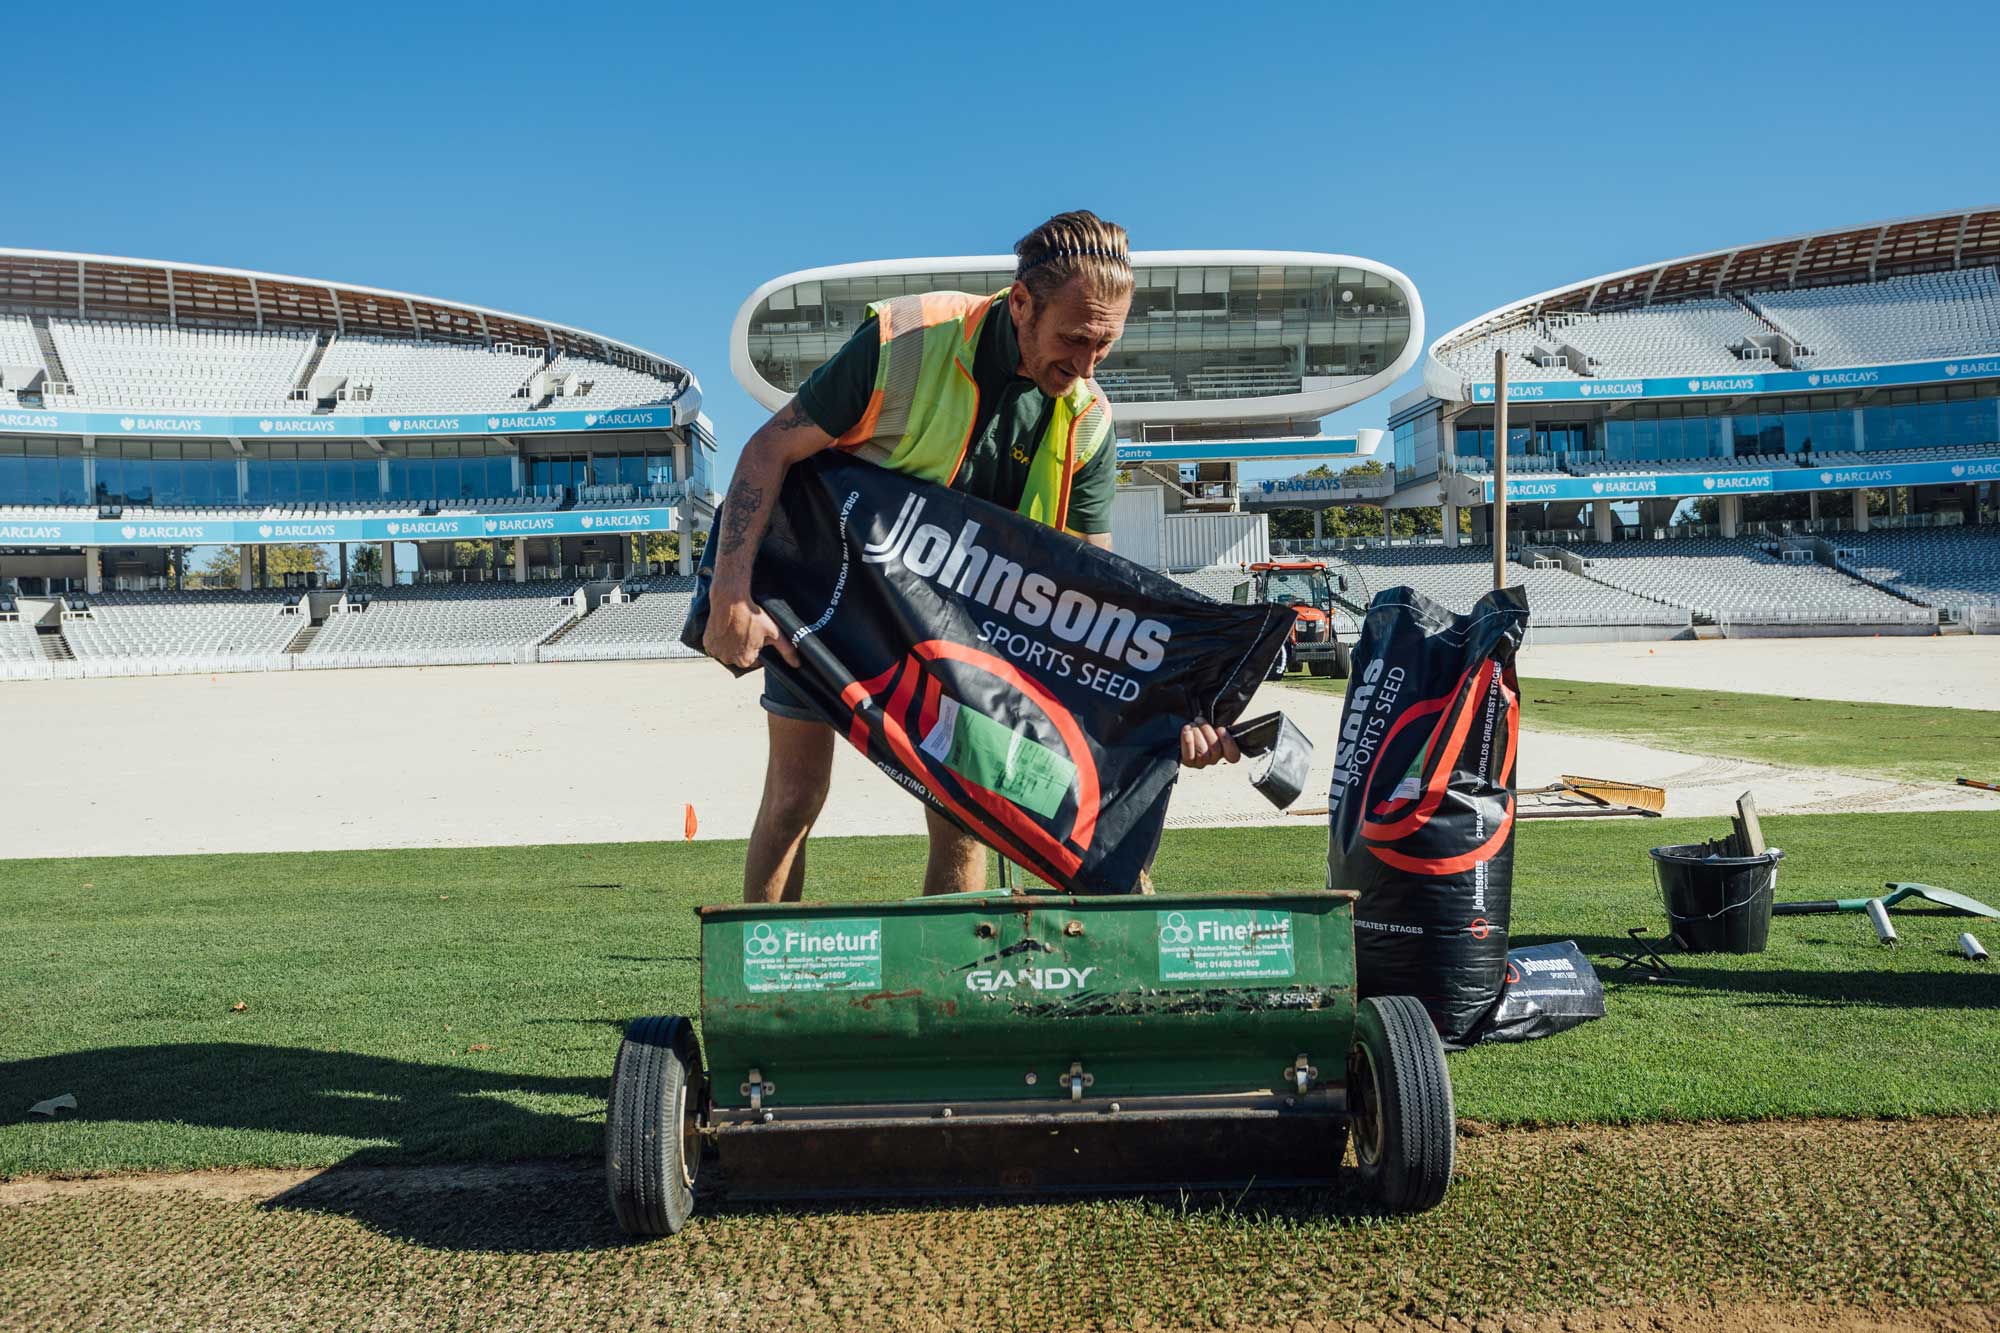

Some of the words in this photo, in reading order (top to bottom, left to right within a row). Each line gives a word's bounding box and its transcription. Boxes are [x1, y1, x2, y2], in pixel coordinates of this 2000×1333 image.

[1961, 362, 2000, 374] BARCL
[1822, 372, 1879, 384] BARCLAYS
[1493, 386, 1543, 397] RCLAYS
[1593, 383, 1643, 395] BARCLAYS
[1702, 379, 1754, 391] BARCLAYS
[0, 414, 58, 427] ARCLAYS
[137, 418, 201, 431] BARCLAYS
[403, 418, 459, 431] BARCLAYS
[502, 416, 556, 428] BARCLAYS
[599, 413, 653, 425] BARCLAYS
[275, 420, 335, 432] BARCLAYS
[1117, 449, 1152, 458] Centre
[1835, 470, 1892, 483] BARCLAYS
[1968, 464, 2000, 476] BARC
[1279, 479, 1340, 492] BARCLAYS
[1605, 481, 1657, 492] BARCLAYS
[1717, 476, 1770, 488] BARCLAYS
[402, 521, 458, 534] BARCLAYS
[500, 518, 554, 531] BARCLAYS
[595, 514, 650, 528] BARCLAYS
[0, 526, 61, 538] ARCLAYS
[139, 526, 203, 538] BARCLAYS
[275, 525, 335, 537] BARCLAYS
[831, 562, 849, 606] WORLDS
[862, 491, 1171, 672] Johnsons
[977, 620, 1074, 677] SPORTS
[1077, 662, 1140, 702] SEED
[1483, 696, 1496, 743] GREATEST
[1490, 661, 1501, 696] STAGES
[1347, 716, 1385, 787] SPORTS
[1375, 666, 1406, 714] SEED
[876, 761, 926, 795] CREATING
[1472, 859, 1487, 912] Johnsons
[1198, 918, 1289, 941] Fineturf
[1353, 919, 1388, 932] GREATEST
[1390, 924, 1424, 935] STAGES
[785, 929, 880, 953] Fineturf
[1515, 958, 1574, 976] Johnsons
[966, 967, 1094, 992] GANDY
